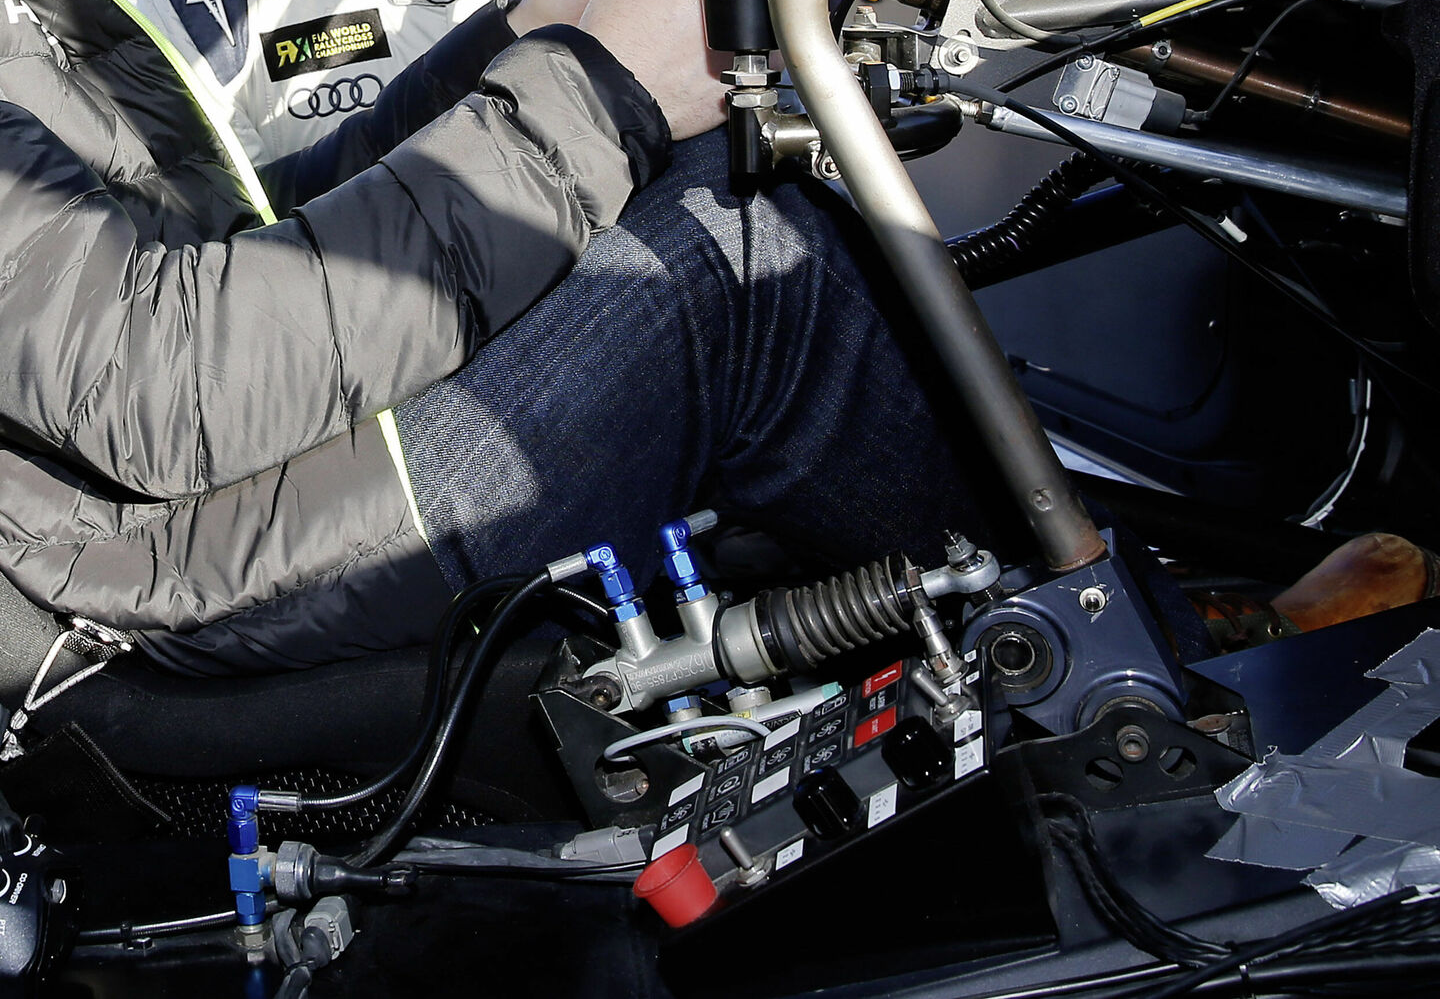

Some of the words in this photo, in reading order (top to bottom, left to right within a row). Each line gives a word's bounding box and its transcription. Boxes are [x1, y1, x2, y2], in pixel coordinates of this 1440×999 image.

[312, 32, 329, 44] FIA
[330, 23, 371, 38] WORLD
[314, 32, 373, 51] RALLYCROSS
[315, 41, 375, 59] CHAMPIONSHIP
